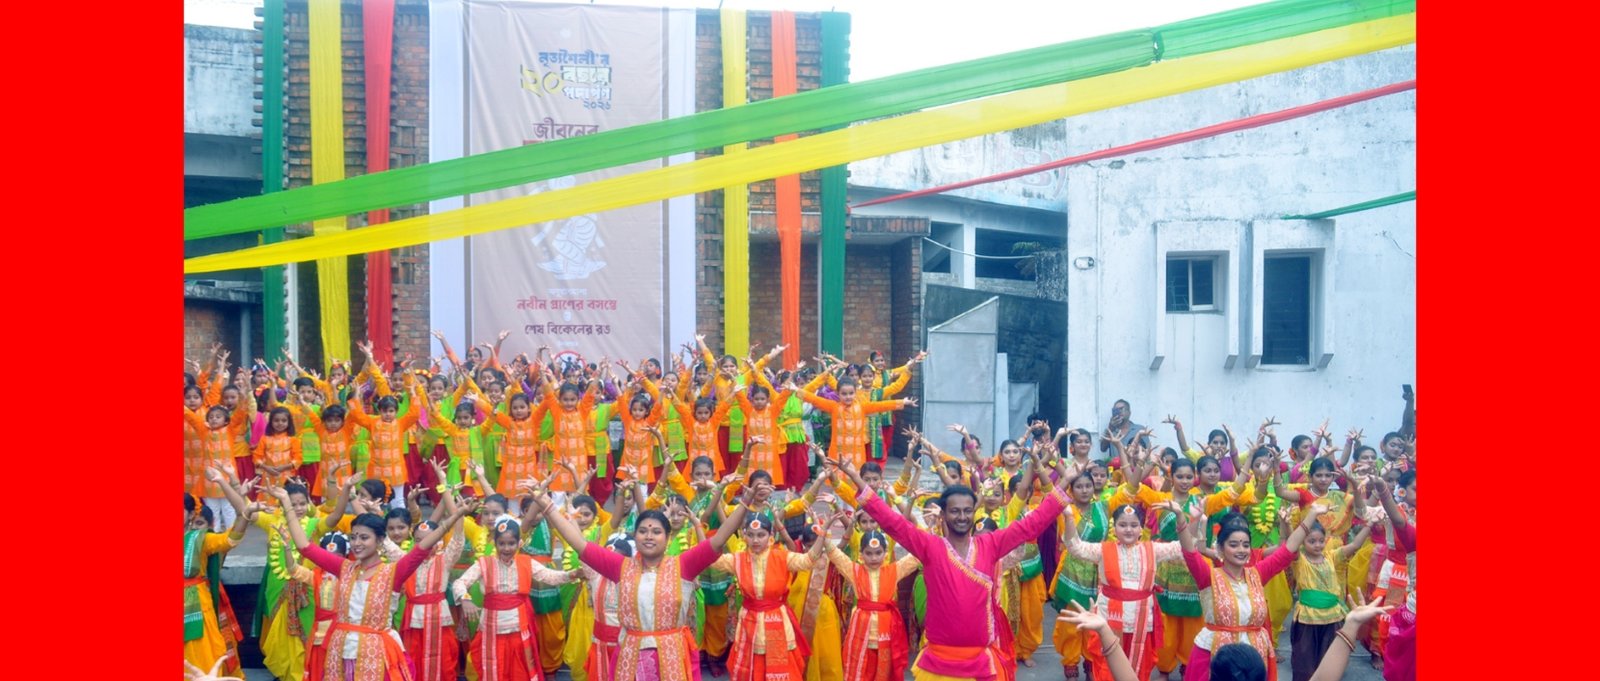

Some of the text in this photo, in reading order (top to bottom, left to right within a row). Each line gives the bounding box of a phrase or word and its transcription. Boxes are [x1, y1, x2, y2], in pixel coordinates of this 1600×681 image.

[516, 295, 617, 311] নবীন প্রাণের বসন্তে
[524, 324, 544, 335] শেষ
[546, 321, 593, 336] বিকেলের
